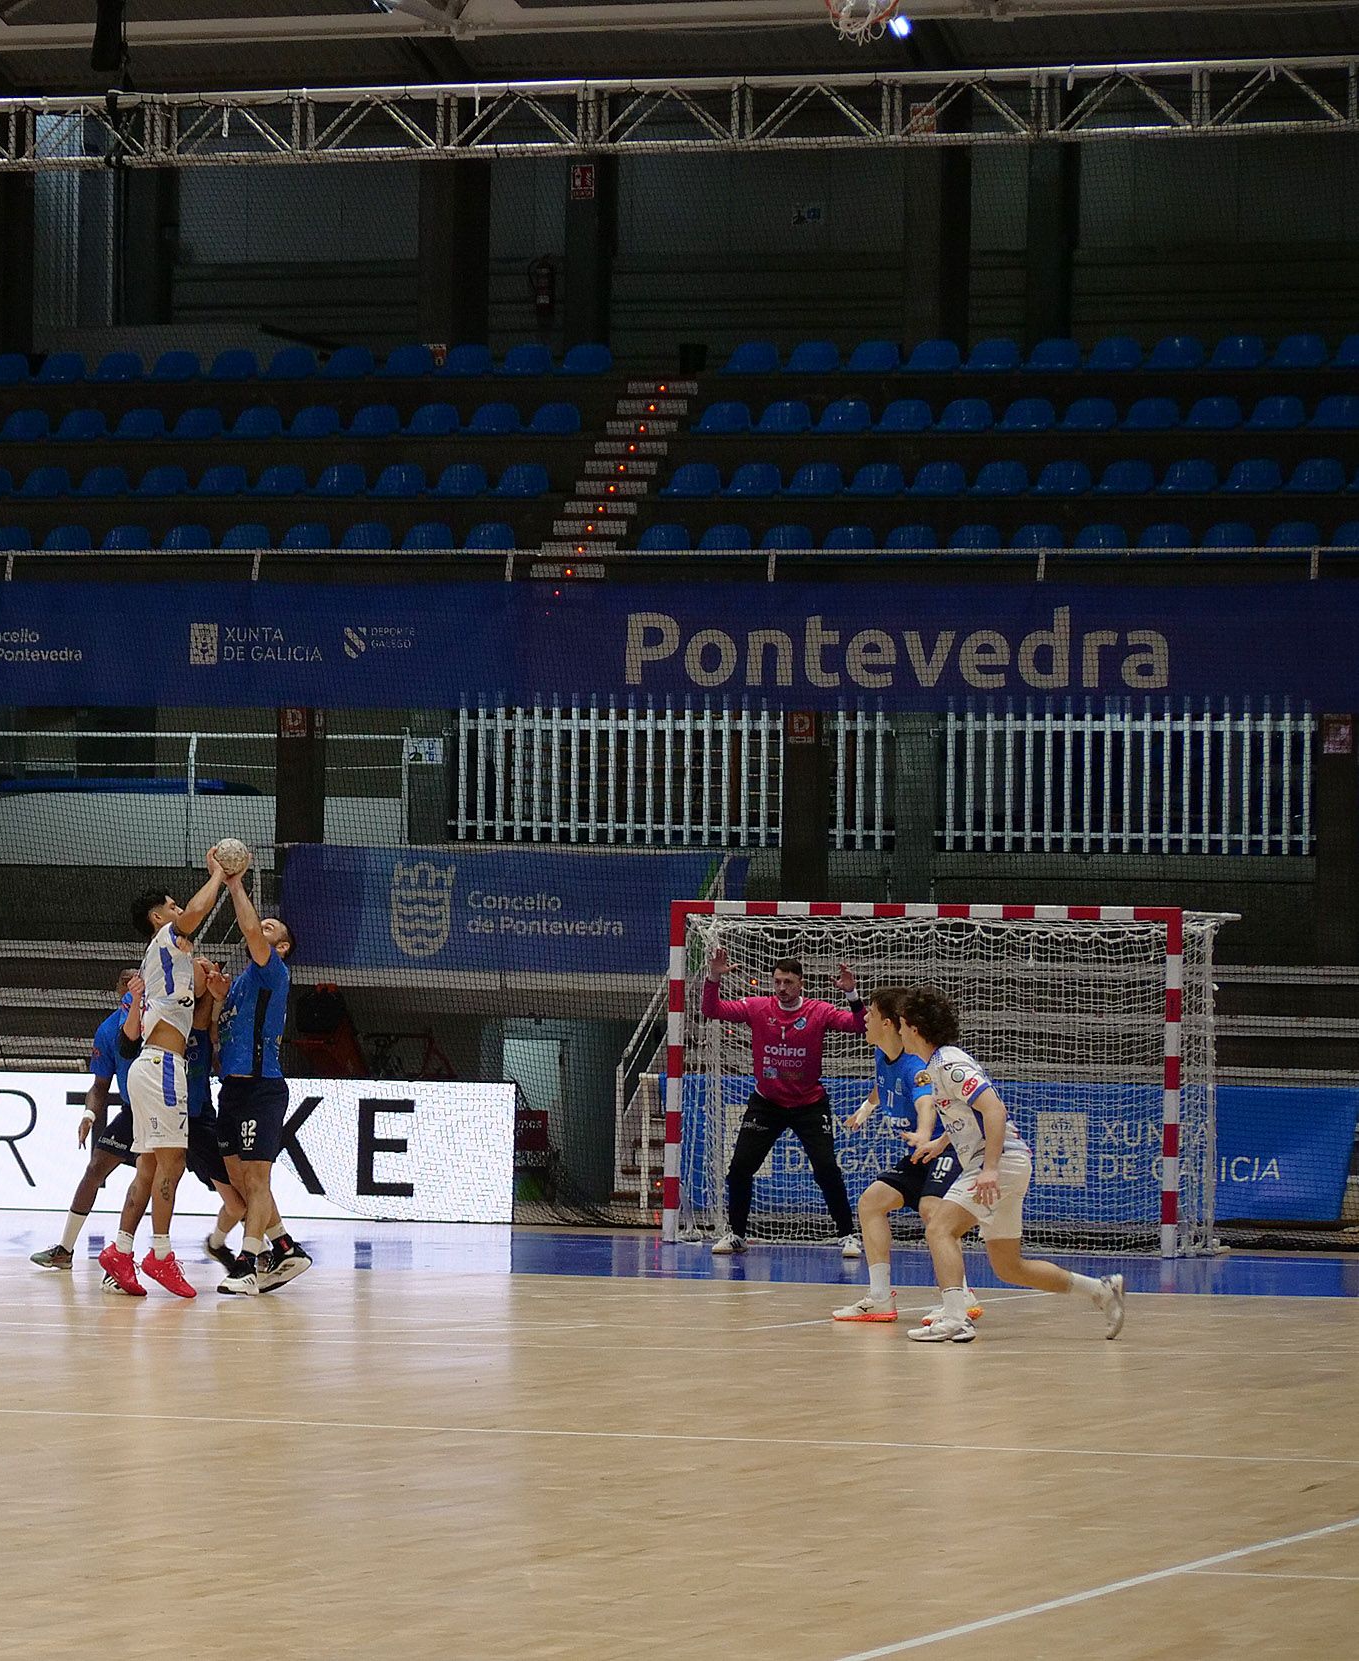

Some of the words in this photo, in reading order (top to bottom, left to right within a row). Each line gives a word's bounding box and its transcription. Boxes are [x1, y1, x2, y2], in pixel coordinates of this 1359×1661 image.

[224, 627, 284, 642] XUNTA
[223, 646, 245, 661] DE
[251, 646, 323, 661] GALICIA
[625, 605, 1170, 689] Pontevedra
[468, 890, 562, 911] Concello
[467, 914, 494, 934] de
[500, 915, 624, 936] Pontevedra
[771, 1058, 802, 1068] OVIEDO
[936, 1156, 953, 1171] 10
